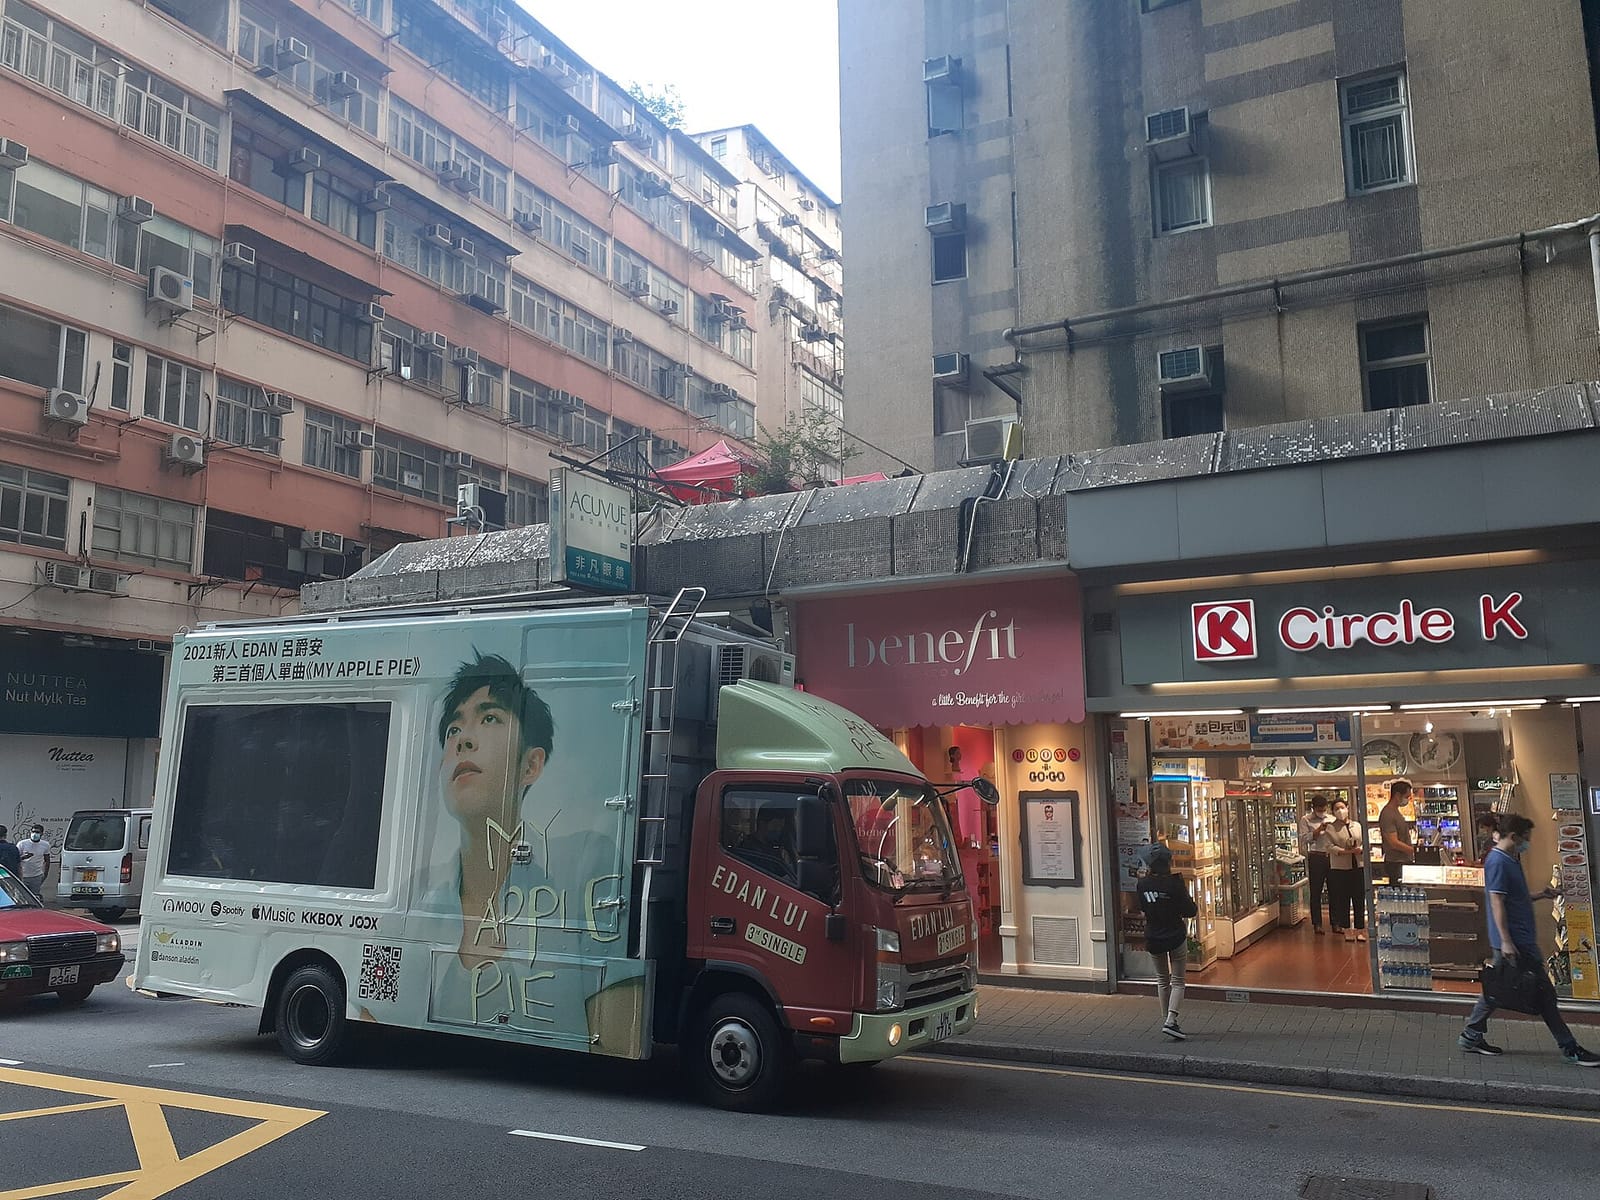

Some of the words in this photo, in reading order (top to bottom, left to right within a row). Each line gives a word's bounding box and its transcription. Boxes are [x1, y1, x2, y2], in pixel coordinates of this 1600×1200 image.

[569, 490, 627, 526] ACUVUE
[575, 555, 625, 580] 非凡眼鏡
[1279, 599, 1455, 652] Circle
[1480, 592, 1528, 640] K
[1203, 607, 1250, 656] K
[242, 641, 278, 658] EDAN
[281, 638, 323, 658] 呂爵安
[844, 610, 1025, 676] benefit
[336, 660, 384, 677] APPLE
[7, 672, 88, 689] NUTTEA
[5, 689, 29, 702] Nut
[34, 690, 63, 706] Mylk
[66, 693, 87, 705] Tea
[939, 693, 954, 706] little
[955, 691, 984, 708] Benefit
[985, 692, 998, 708] for
[998, 691, 1010, 704] the
[48, 747, 95, 761] Nuttea
[1014, 749, 1079, 761] BROWS
[486, 809, 562, 879] MY
[175, 900, 206, 914] MOOV
[711, 865, 767, 910] EDAN
[769, 895, 808, 932] LUI
[222, 905, 245, 916] Spotify
[261, 906, 296, 923] Music
[301, 911, 343, 927] KKBOX
[349, 915, 379, 930] JOOX
[474, 874, 624, 969] APPLE
[911, 911, 938, 940] EDAN
[938, 906, 954, 931] LUI
[170, 938, 203, 947] ALADDIN
[761, 932, 804, 962] SINGLE
[471, 959, 556, 1024] PIE
